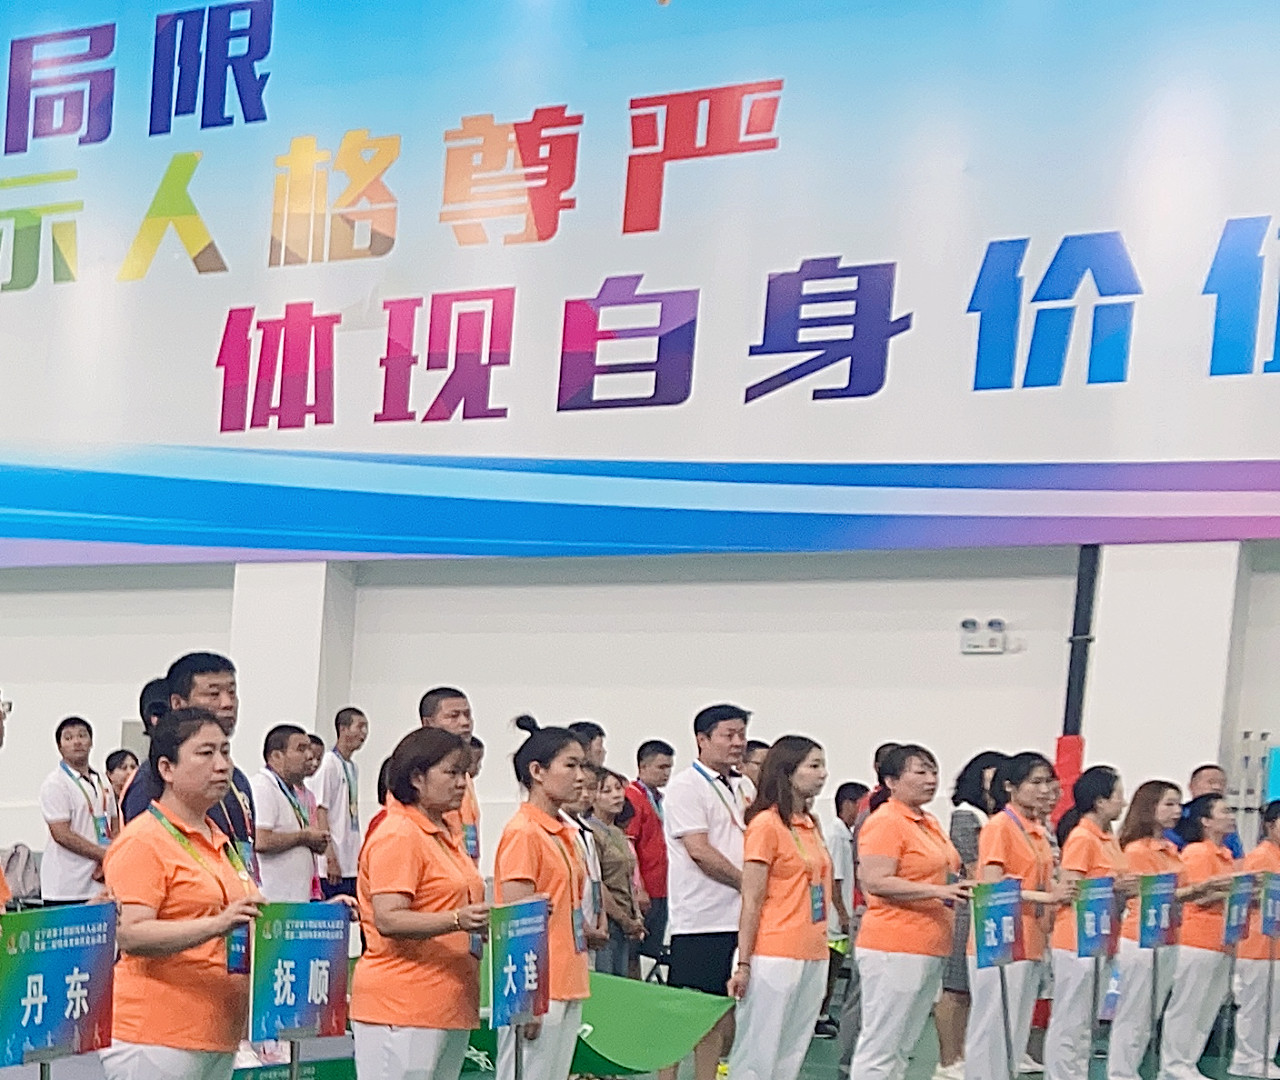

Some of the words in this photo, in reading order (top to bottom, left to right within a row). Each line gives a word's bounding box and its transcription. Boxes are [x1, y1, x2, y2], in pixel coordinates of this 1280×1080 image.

[21, 966, 91, 1027] 丹东
[273, 957, 331, 1006] 抚顺
[503, 950, 538, 997] 大连
